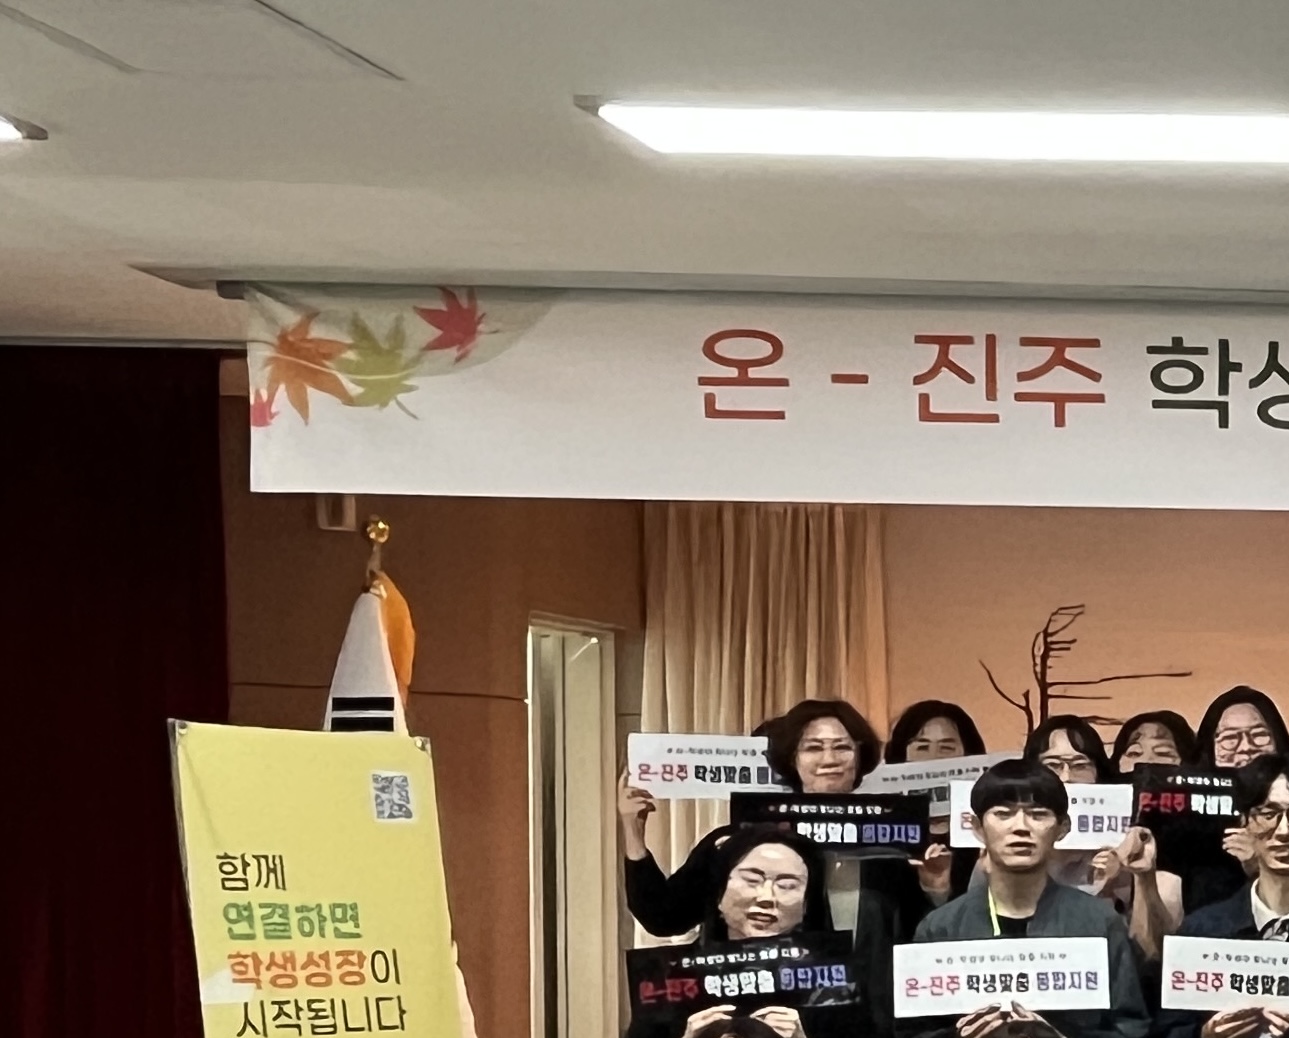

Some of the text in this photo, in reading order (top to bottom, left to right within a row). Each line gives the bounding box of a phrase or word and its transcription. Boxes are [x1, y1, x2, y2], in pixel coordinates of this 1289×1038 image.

[695, 329, 791, 421] 온
[914, 329, 1105, 430] 진주
[216, 852, 286, 892] 함께
[223, 901, 362, 941] 연결하면
[228, 948, 400, 990] 학생성장이
[237, 996, 407, 1038] 시작됩니다
